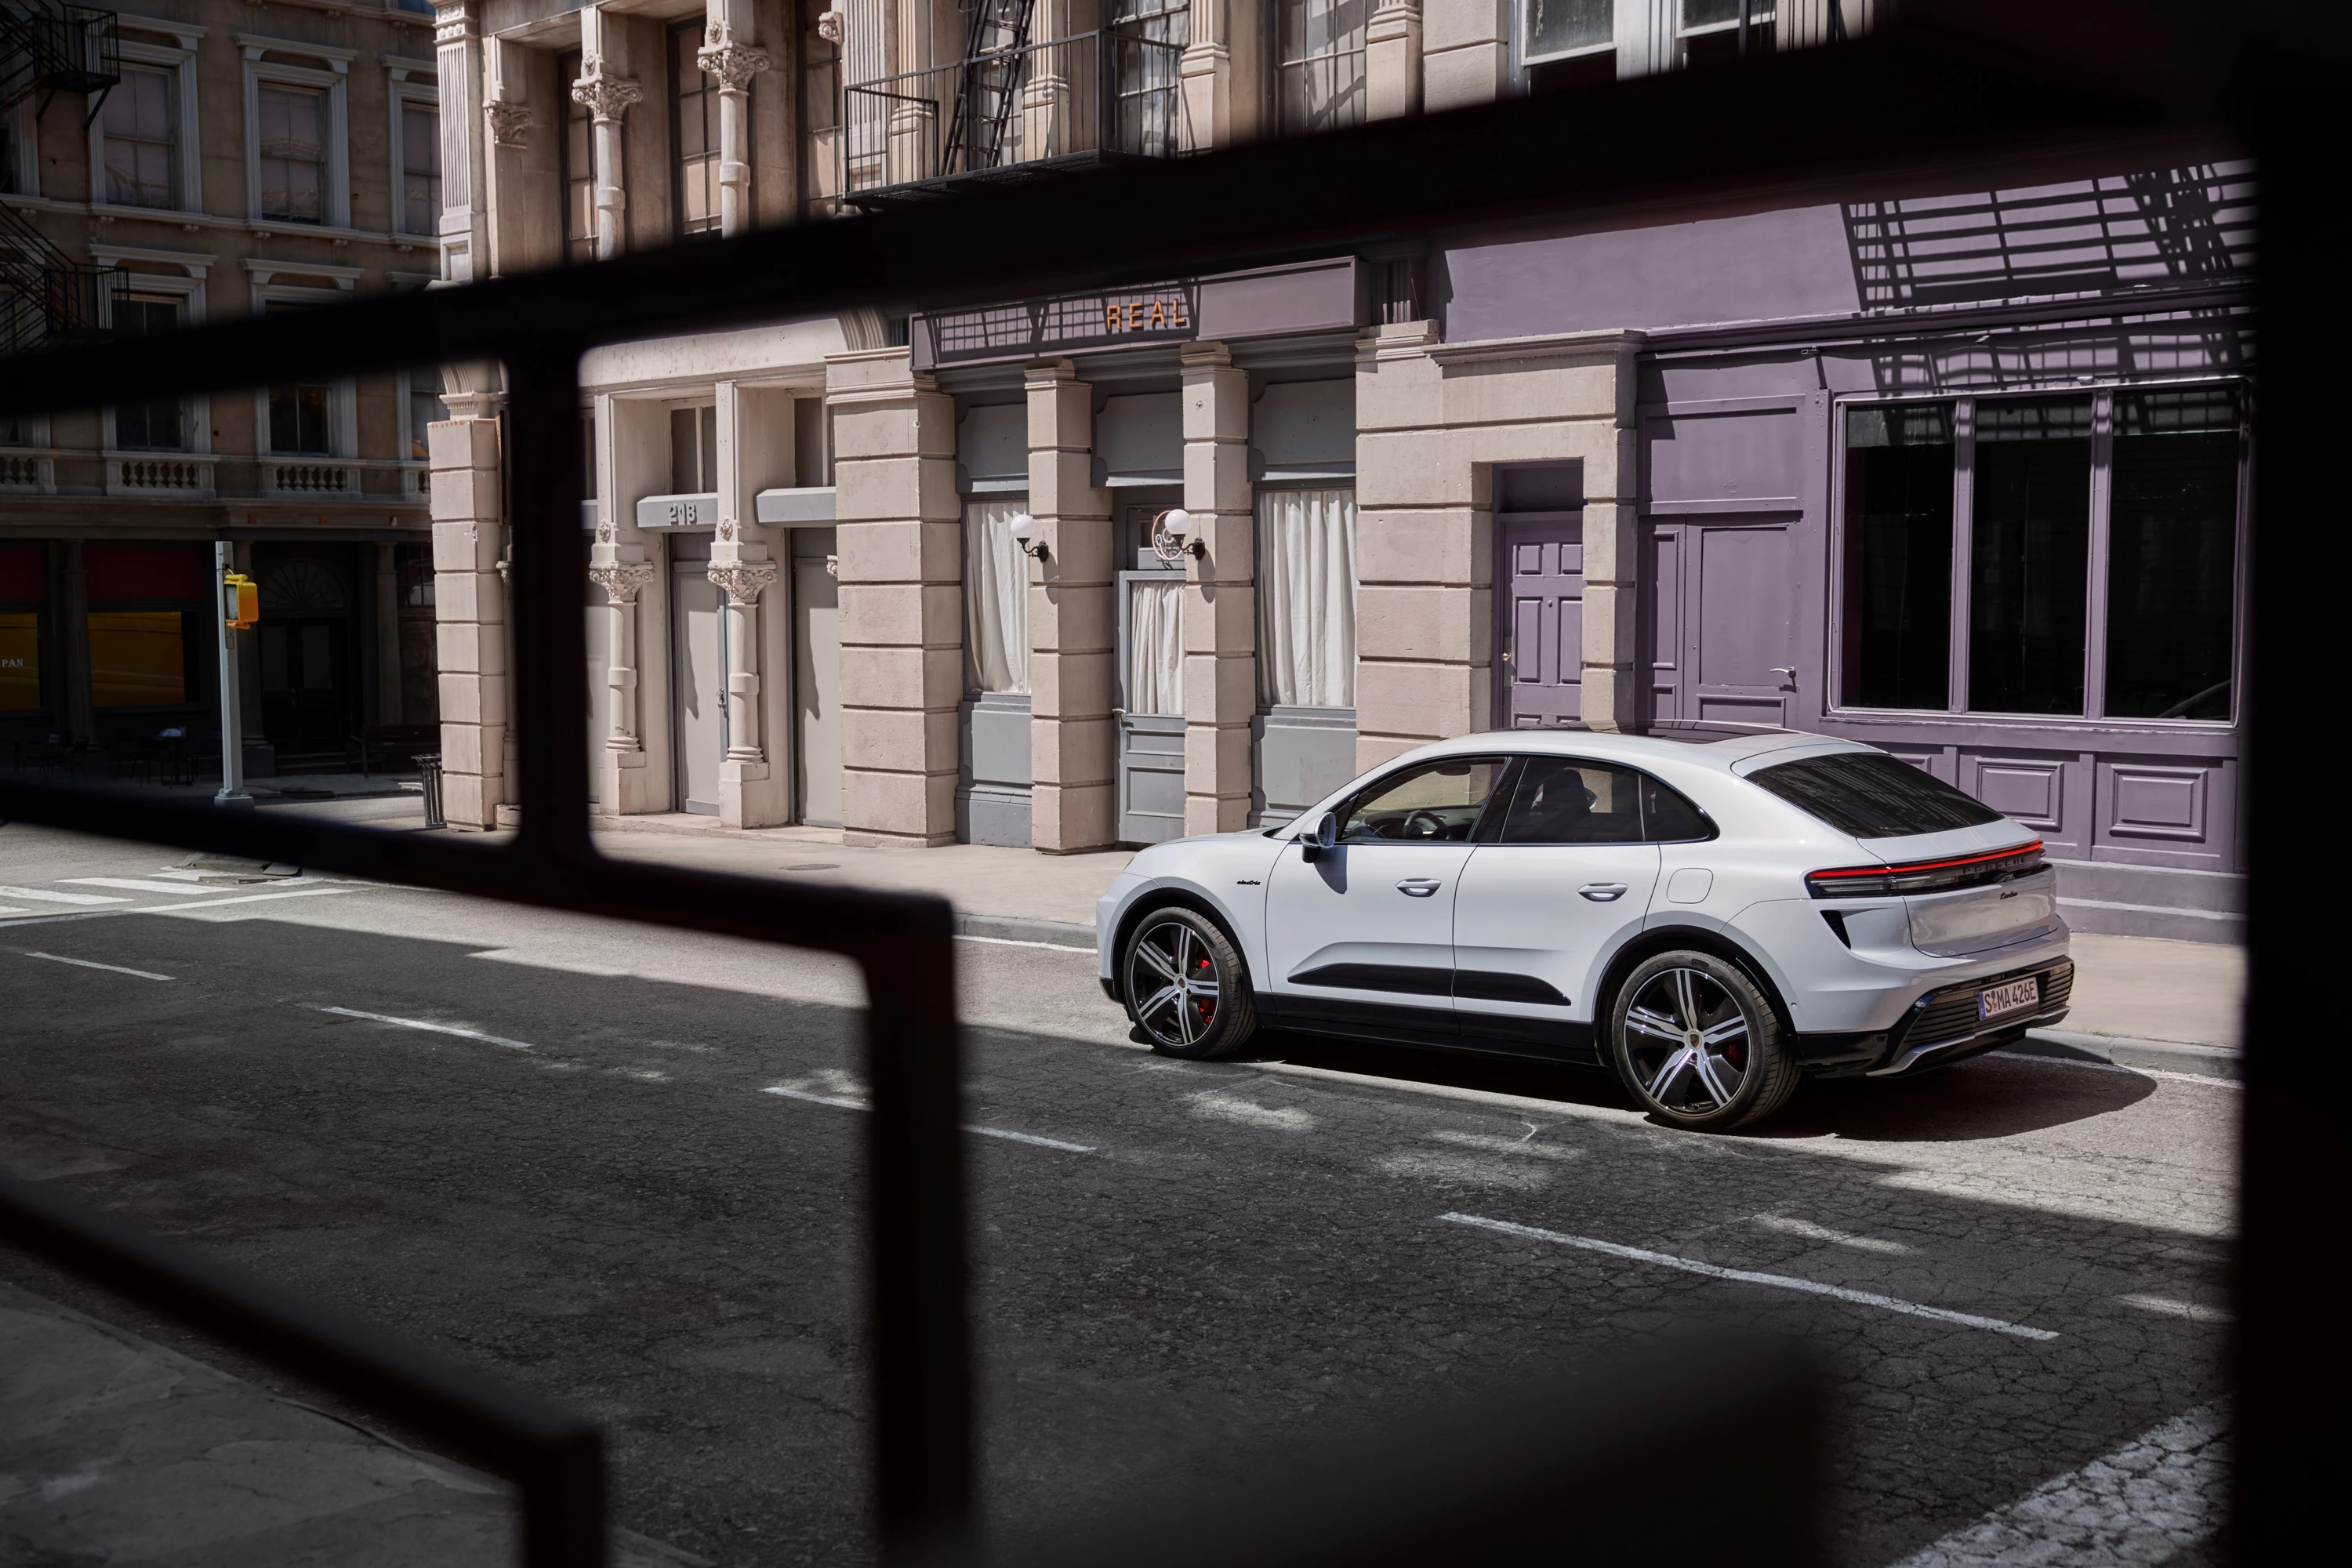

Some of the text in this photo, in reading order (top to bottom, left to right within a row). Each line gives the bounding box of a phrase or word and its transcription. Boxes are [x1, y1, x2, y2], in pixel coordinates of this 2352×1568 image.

[1106, 298, 1187, 330] REAL
[2, 659, 24, 667] PAN
[2013, 981, 2037, 1004] 426E
